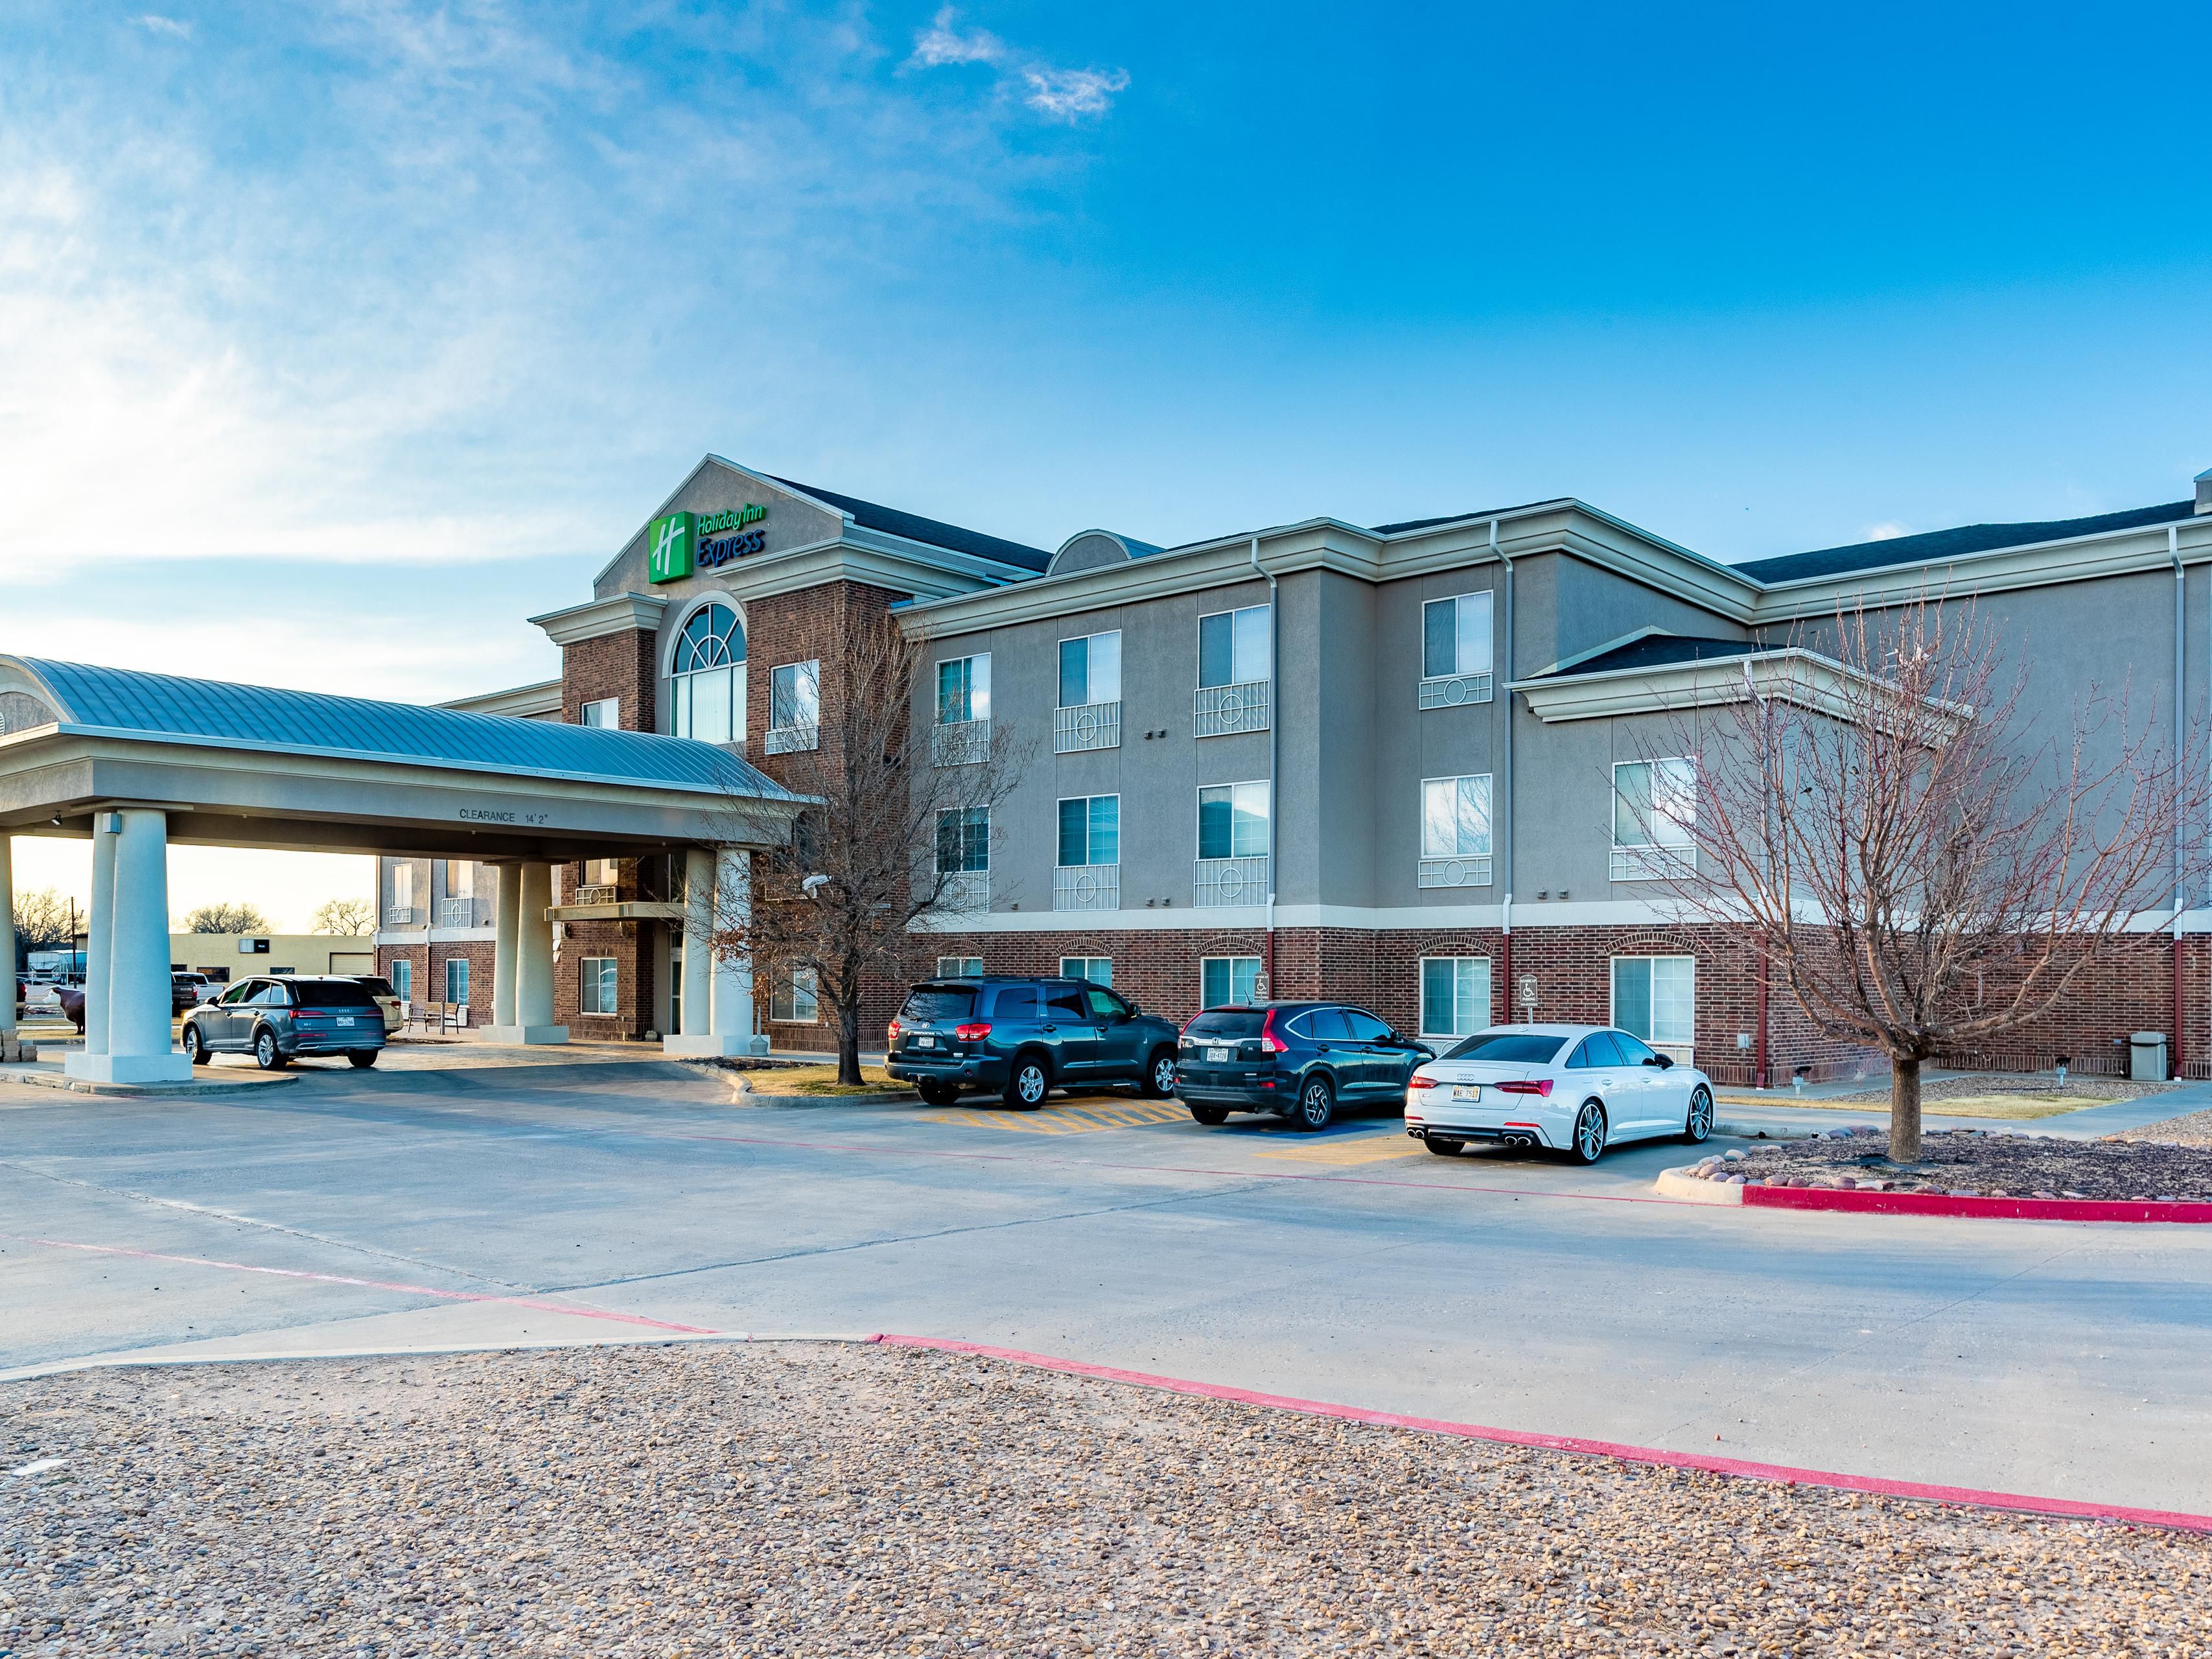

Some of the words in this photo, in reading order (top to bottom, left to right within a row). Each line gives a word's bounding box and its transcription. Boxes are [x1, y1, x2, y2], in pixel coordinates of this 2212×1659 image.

[697, 509, 743, 536] Holiday
[743, 503, 766, 524] Inn
[696, 529, 765, 568] Express
[460, 809, 515, 822] CLEARANCE
